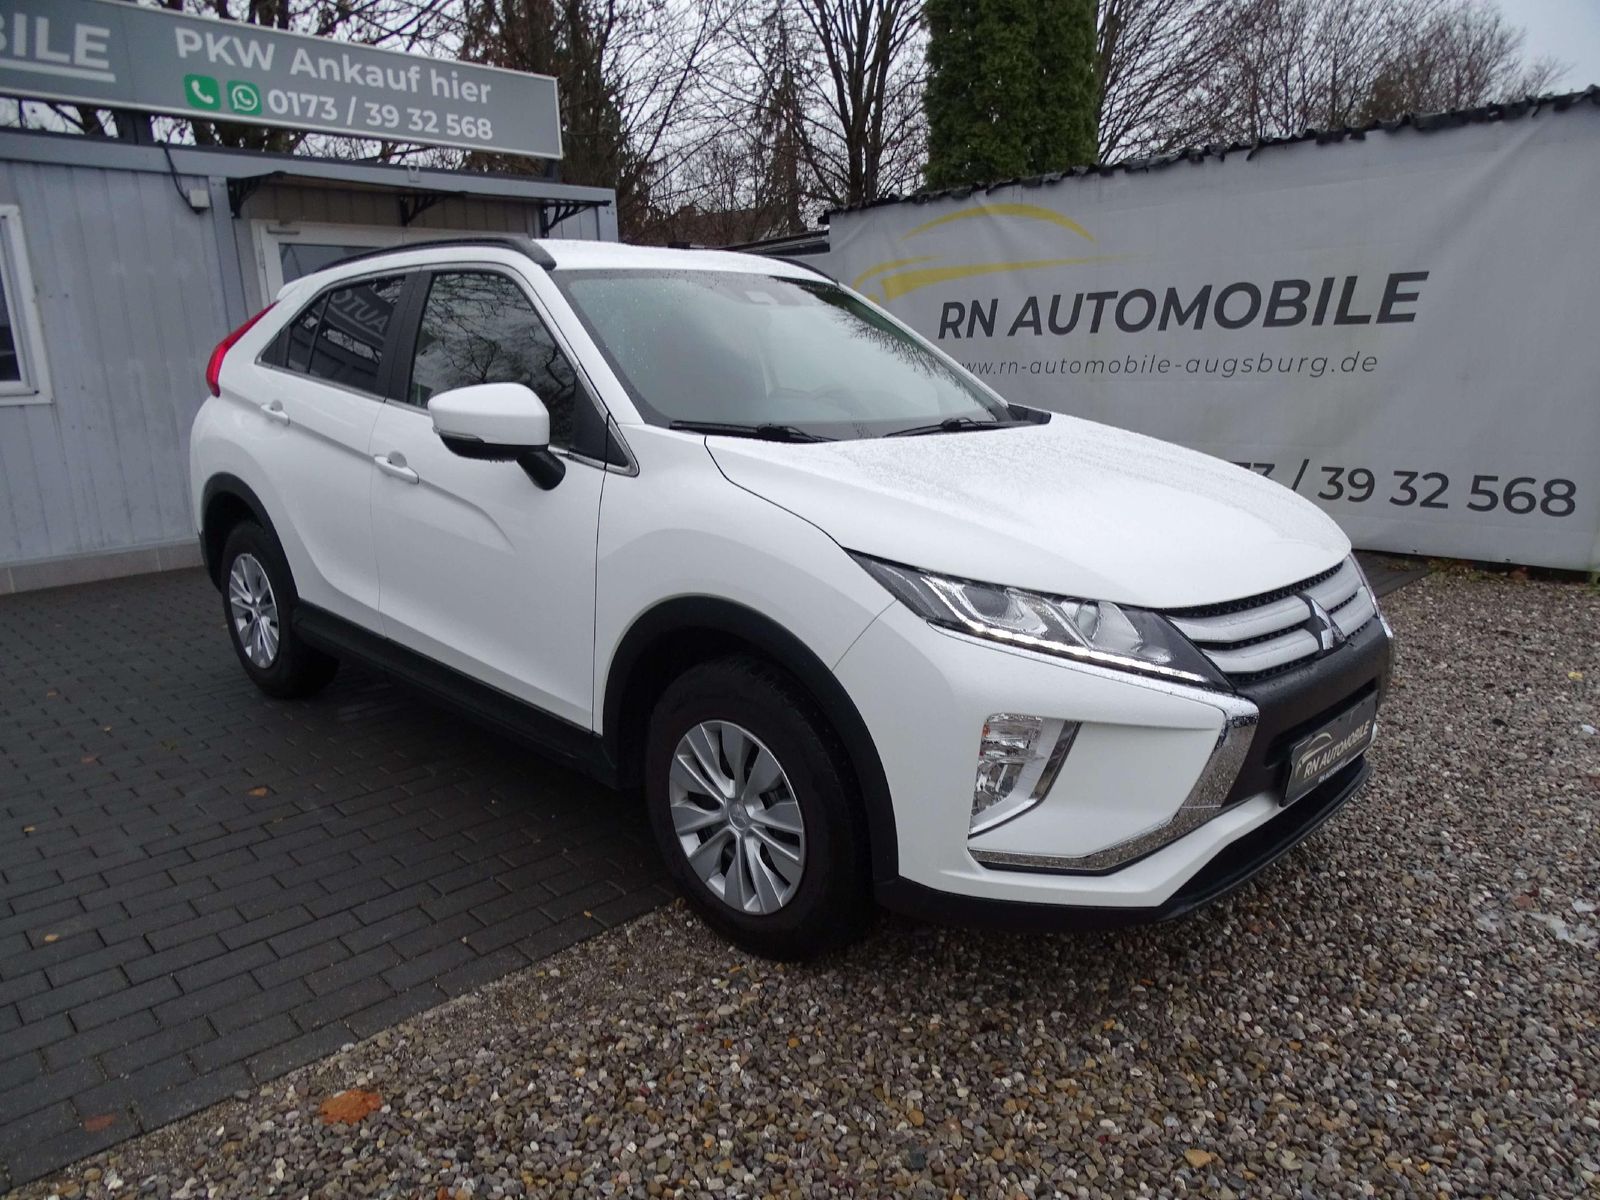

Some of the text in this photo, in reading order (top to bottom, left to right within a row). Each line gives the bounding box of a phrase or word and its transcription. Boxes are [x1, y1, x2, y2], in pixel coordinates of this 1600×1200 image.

[0, 11, 111, 69] ILE
[174, 27, 492, 104] PKW Ankauf hier
[267, 88, 492, 140] 0173 / 39 32 568
[938, 271, 1429, 339] RN AUTOMOBILE
[1317, 466, 1376, 503] 39
[1389, 470, 1450, 510] 32
[1466, 475, 1577, 517] 568
[1303, 756, 1321, 779] RN
[1319, 720, 1371, 769] AUTOMOBILE
